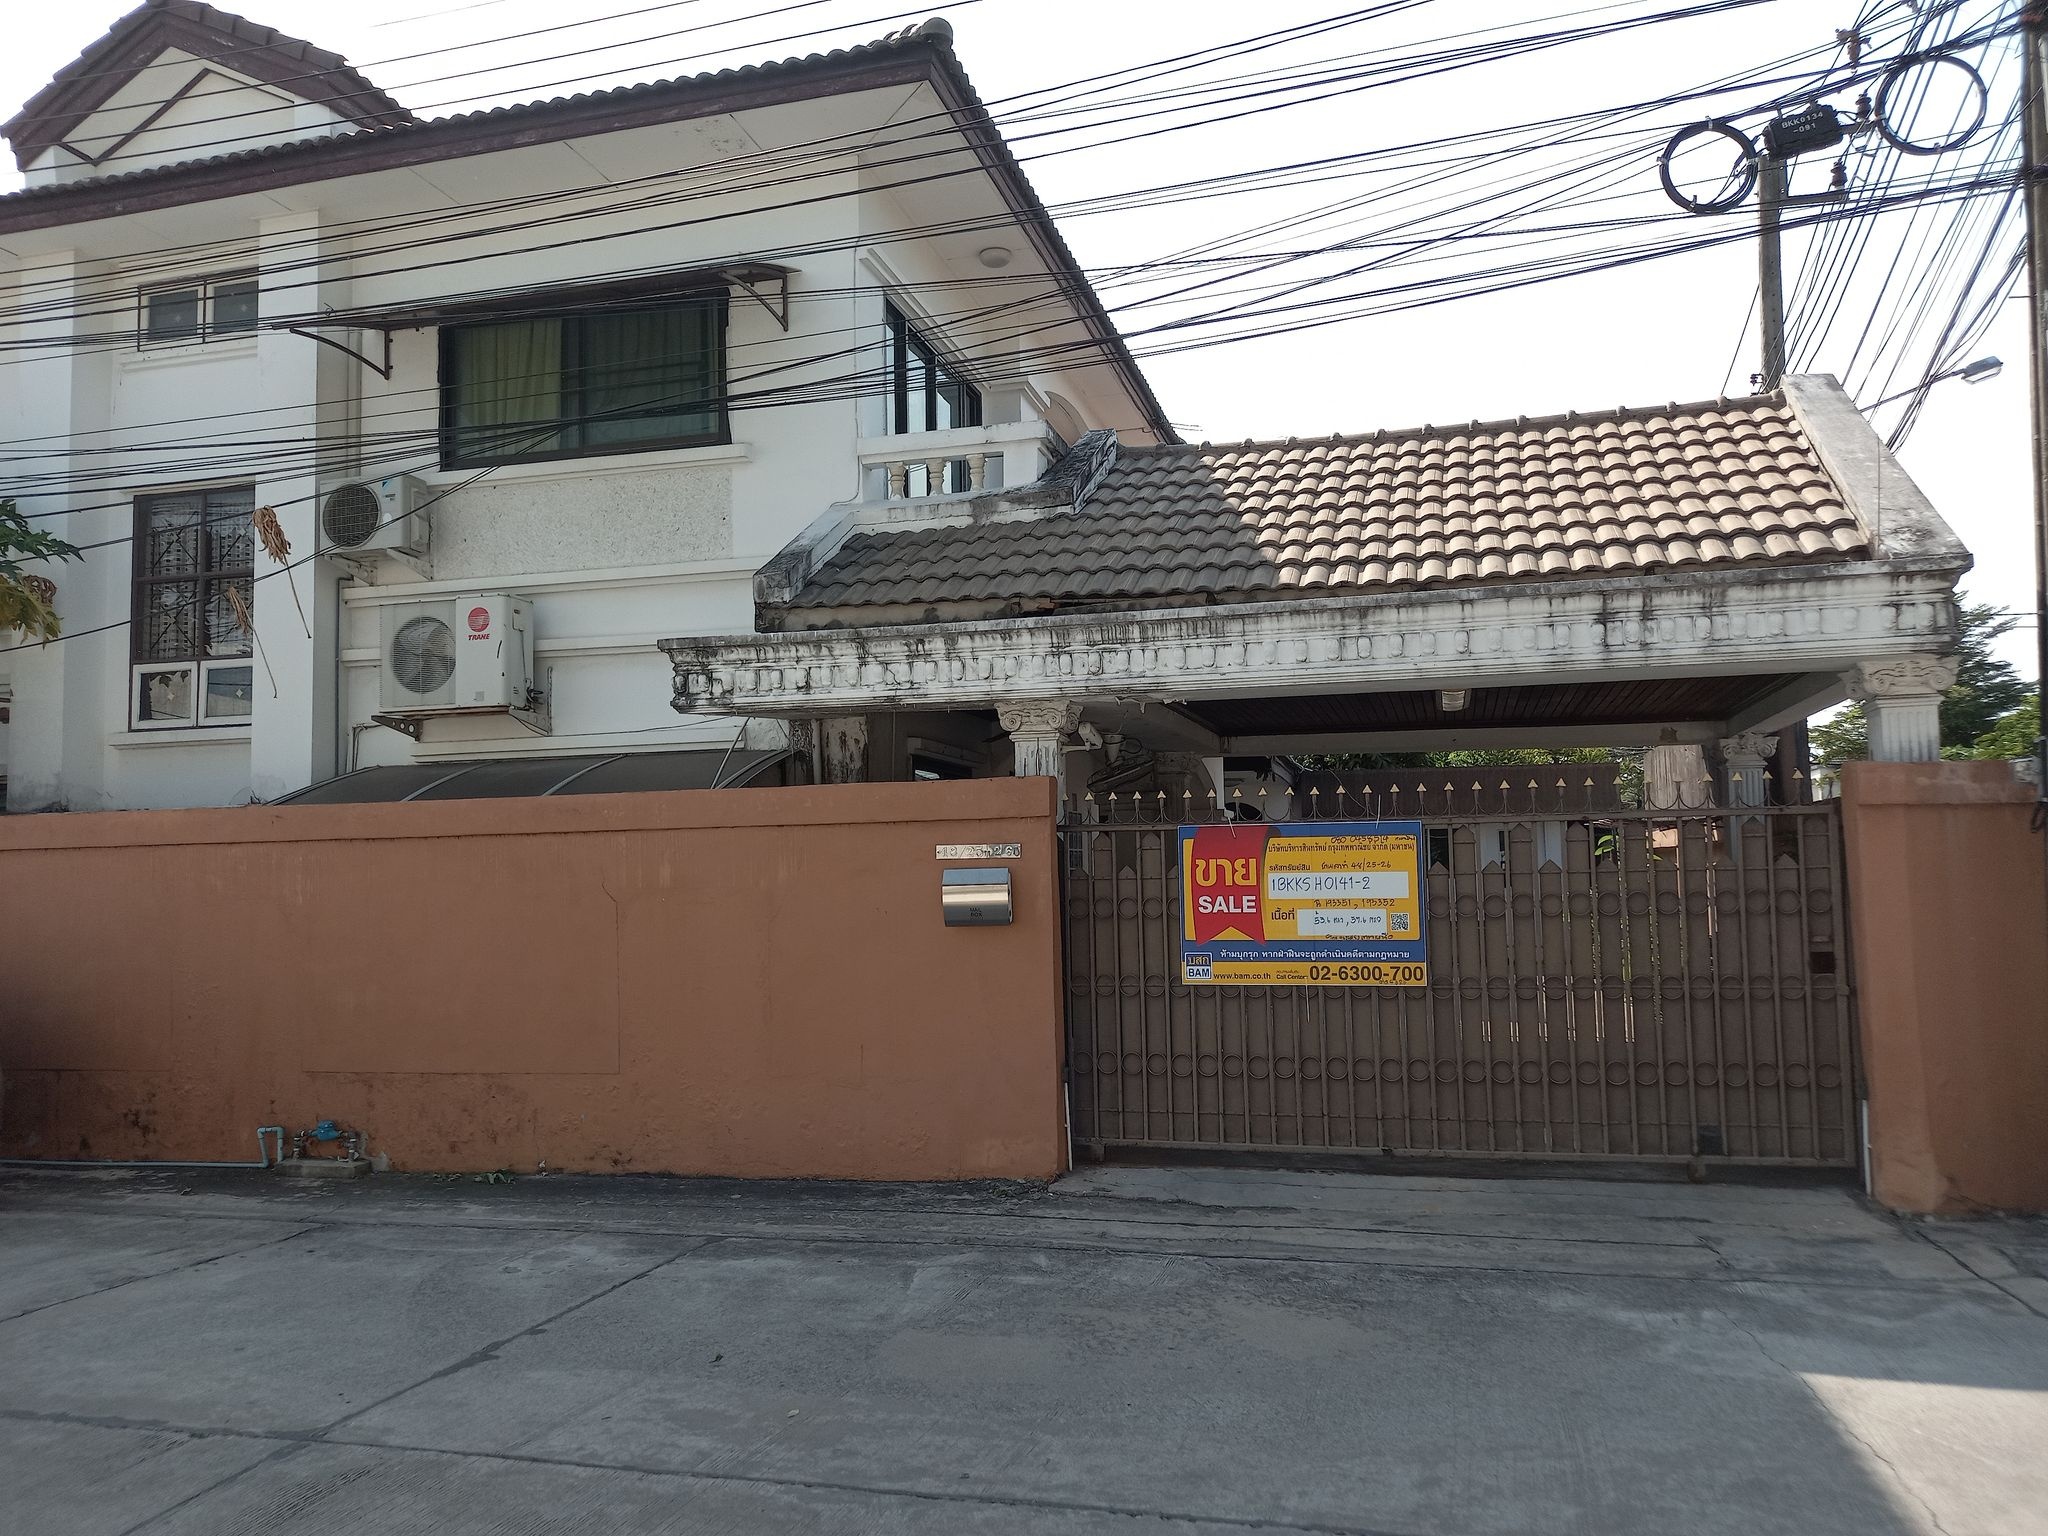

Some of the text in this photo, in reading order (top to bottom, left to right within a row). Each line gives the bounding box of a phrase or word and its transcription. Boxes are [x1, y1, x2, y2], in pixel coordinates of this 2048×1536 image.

[1781, 112, 1823, 129] BKK0134
[1195, 858, 1257, 887] ขาย
[1198, 895, 1257, 914] SALE
[1271, 907, 1295, 921] เนื้อที่
[1188, 955, 1210, 965] บสก
[1220, 949, 1259, 961] ห้ามบุกรุก
[1188, 967, 1210, 978] BAM
[1213, 972, 1271, 980] www.bam.co.th
[1309, 966, 1424, 981] 02-6300-700
